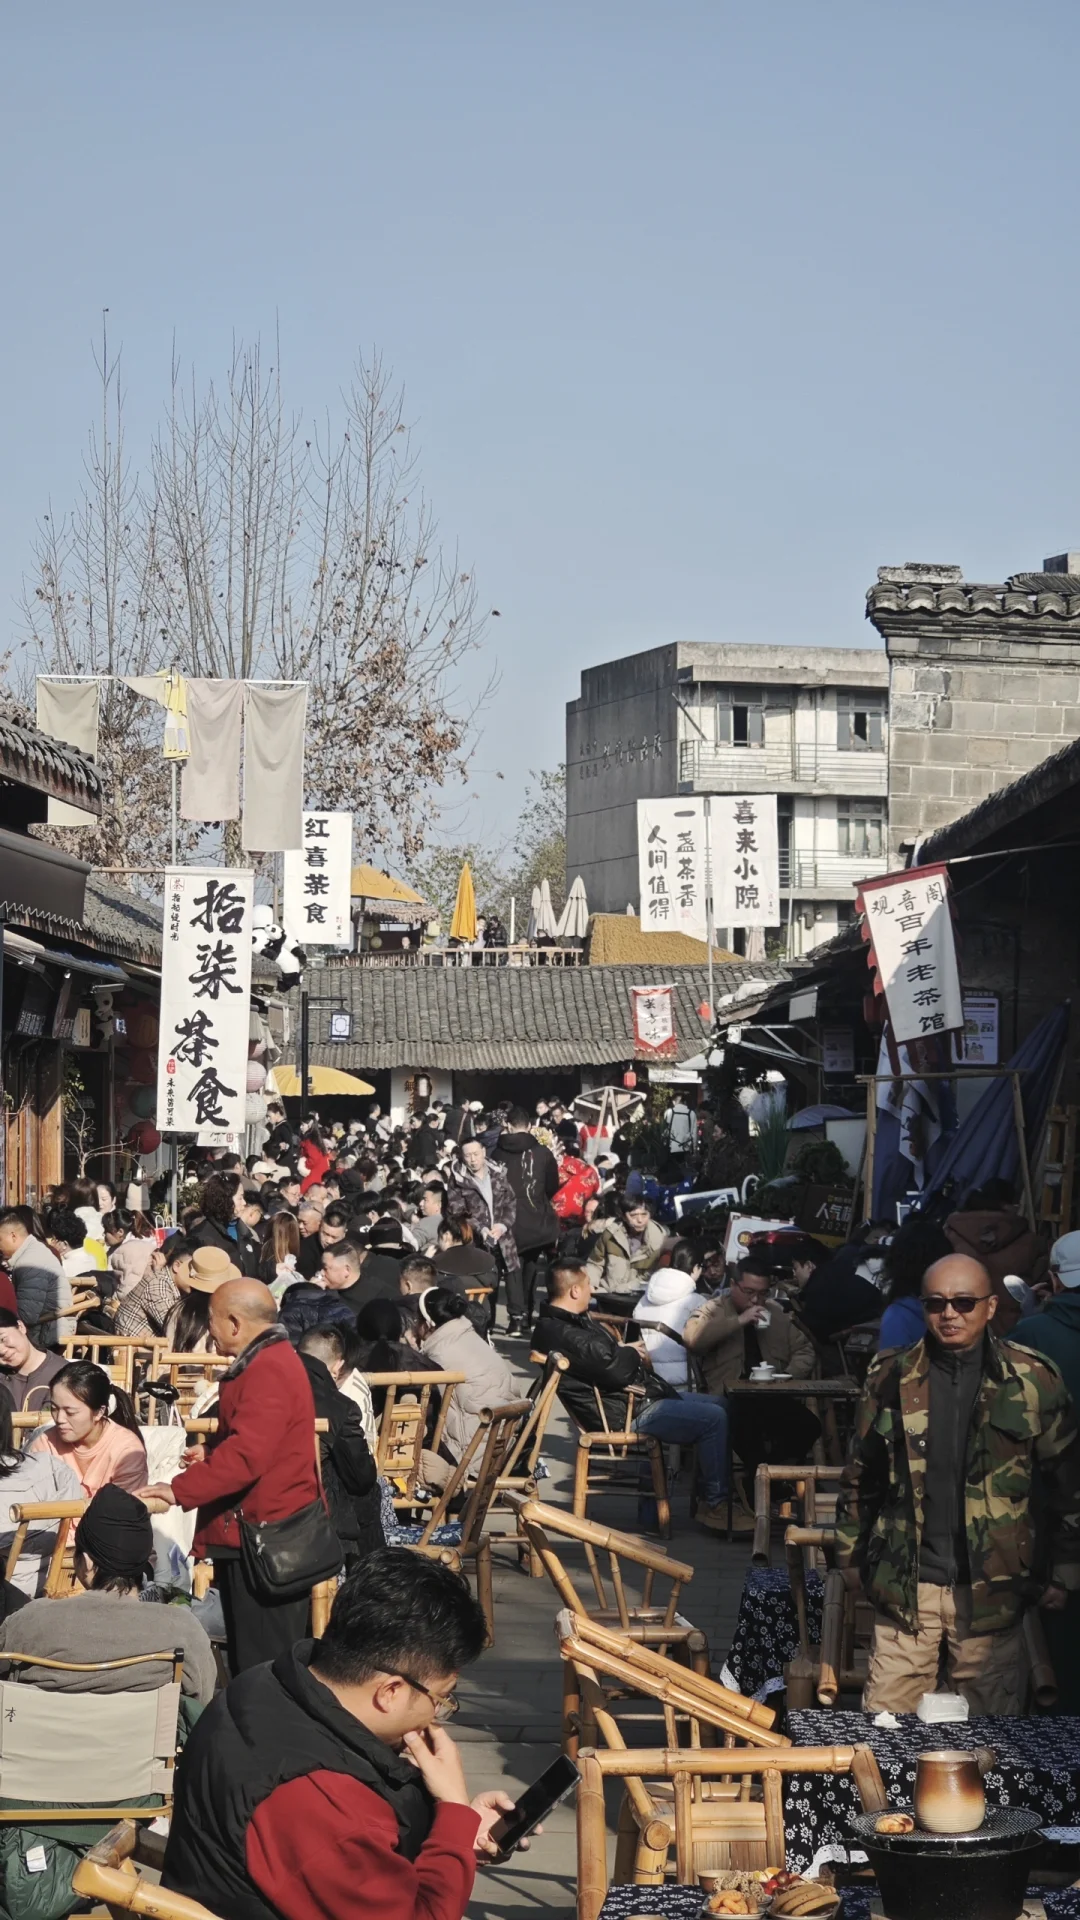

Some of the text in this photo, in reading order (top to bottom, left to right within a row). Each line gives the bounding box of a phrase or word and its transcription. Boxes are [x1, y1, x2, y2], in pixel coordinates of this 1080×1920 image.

[303, 818, 330, 924] 红喜茶食
[647, 825, 669, 920] 人间值得
[674, 810, 697, 908] 一盏茶香
[732, 800, 760, 909] 喜来小院
[871, 881, 946, 917] 观音阁
[169, 880, 246, 1127] 拾柒茶食
[895, 911, 946, 1033] 百年老茶馆
